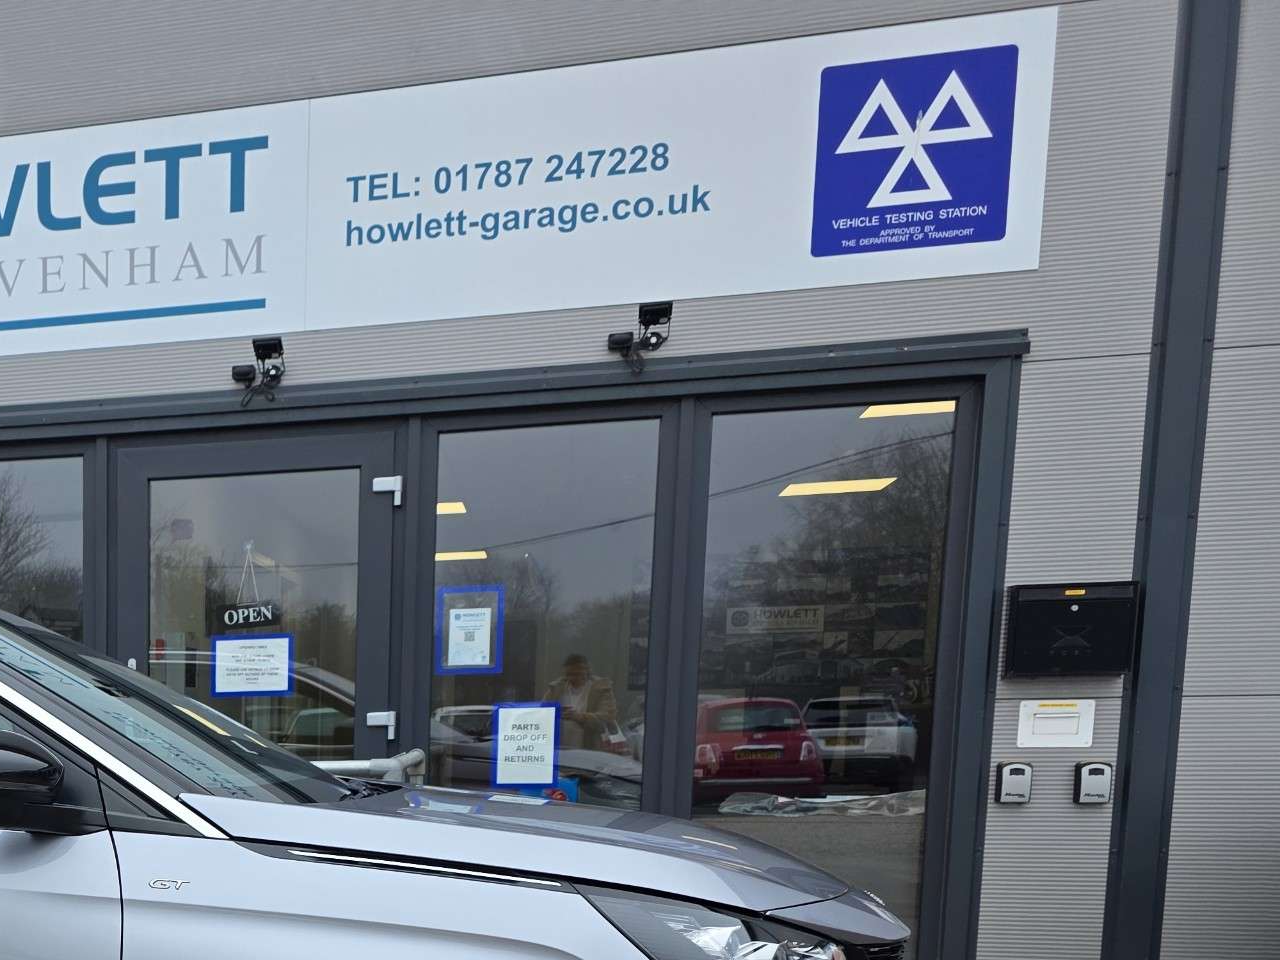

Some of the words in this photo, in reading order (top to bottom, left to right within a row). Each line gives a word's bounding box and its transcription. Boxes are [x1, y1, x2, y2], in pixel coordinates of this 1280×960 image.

[347, 172, 421, 203] TEL:
[434, 158, 533, 195] 01787
[545, 143, 670, 184] 247228
[345, 184, 712, 247] howlett-garage.co.uk
[832, 215, 880, 230] VEHICLE
[885, 210, 934, 225] TESTING
[939, 205, 988, 220] STATION
[841, 239, 857, 248] THE
[859, 235, 909, 246] DEPARTMENT
[913, 233, 925, 241] OF
[928, 228, 975, 240] TRANSPORT
[880, 226, 921, 237] APPROVED
[924, 225, 936, 233] BY
[224, 605, 273, 625] OPEN
[511, 723, 541, 731] PARTS
[515, 744, 535, 752] AND
[504, 755, 545, 763] RETURNS
[148, 879, 191, 891] GT
